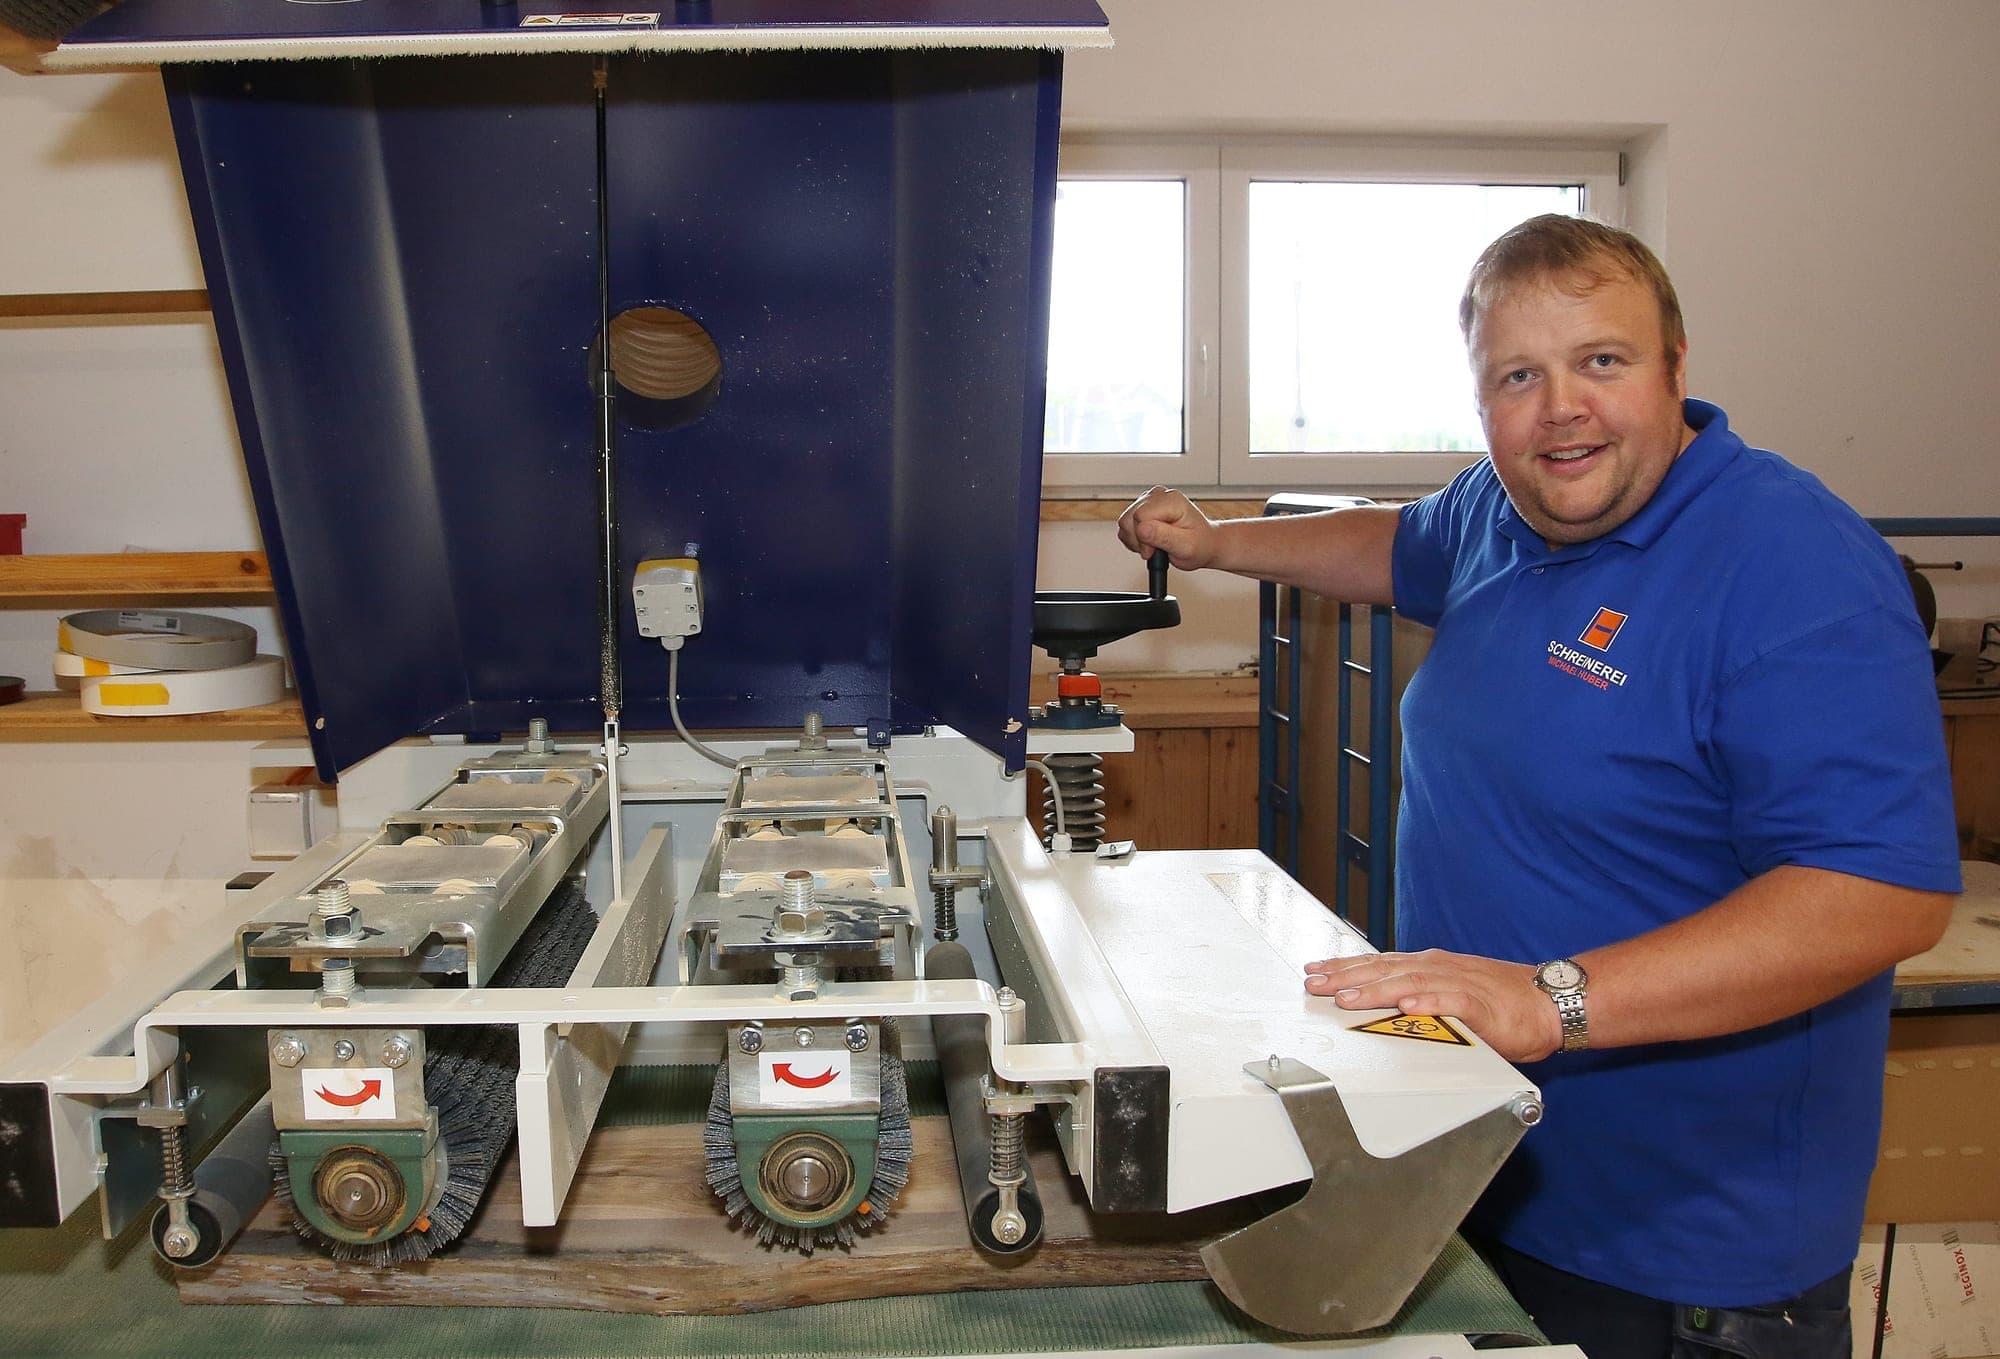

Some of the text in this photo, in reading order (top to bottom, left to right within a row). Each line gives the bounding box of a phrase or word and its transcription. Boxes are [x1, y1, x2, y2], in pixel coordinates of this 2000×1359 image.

[1547, 640, 1628, 687] SCHREINEREI
[1547, 656, 1610, 691] MICHAEL HUBER
[1953, 1248, 1975, 1297] REGINOX
